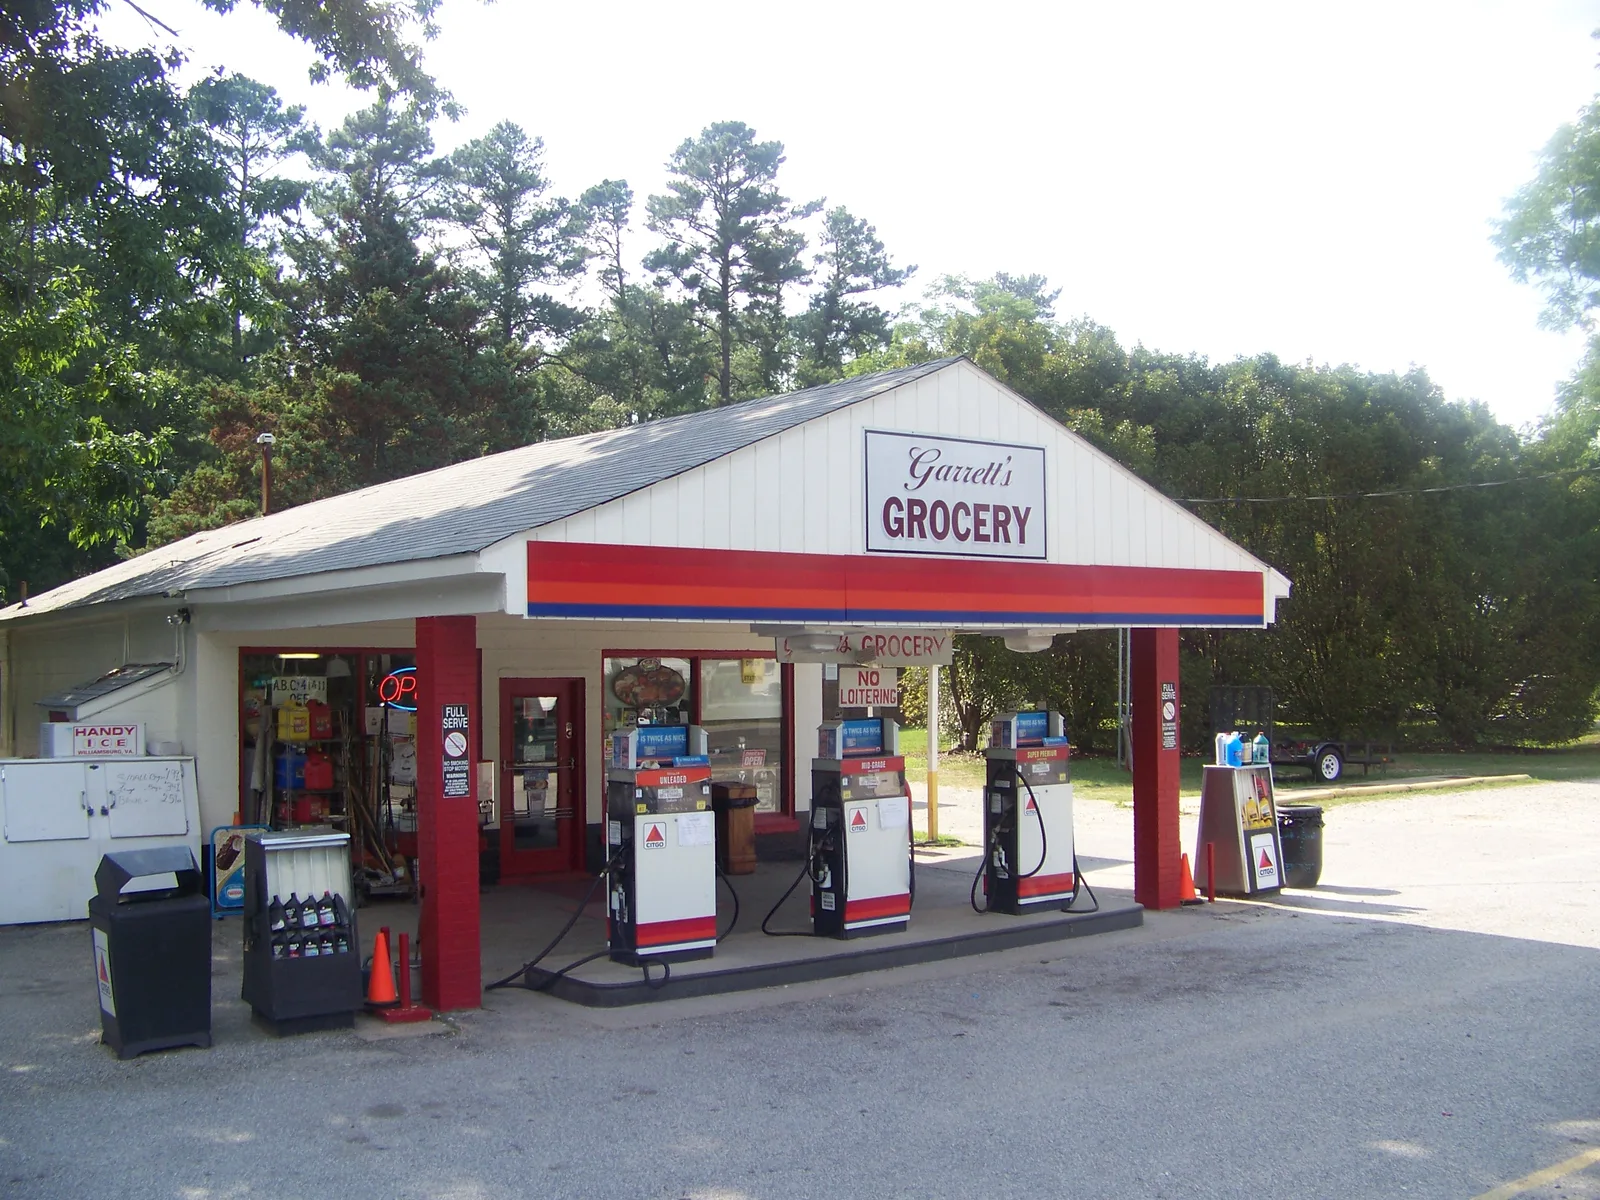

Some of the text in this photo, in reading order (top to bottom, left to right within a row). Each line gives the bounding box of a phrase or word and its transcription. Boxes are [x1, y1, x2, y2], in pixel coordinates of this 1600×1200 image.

[904, 446, 1012, 490] Garrett's
[882, 496, 1031, 544] GROCERY
[862, 634, 946, 657] GROCERY
[858, 670, 880, 686] NO
[379, 675, 418, 701] OP
[1162, 683, 1174, 691] FULL
[840, 689, 897, 705] LOITERING
[1162, 691, 1176, 700] SERVE
[445, 706, 465, 718] FULL
[443, 717, 468, 729] SERVE
[75, 727, 135, 737] HANDY
[87, 739, 126, 747] ICE
[1027, 750, 1057, 759] SUPER PREMIUM
[744, 756, 763, 766] OPEN
[862, 760, 886, 770] MID-GRADE
[660, 776, 687, 785] UNLEADED
[1259, 868, 1274, 876] CITGO
